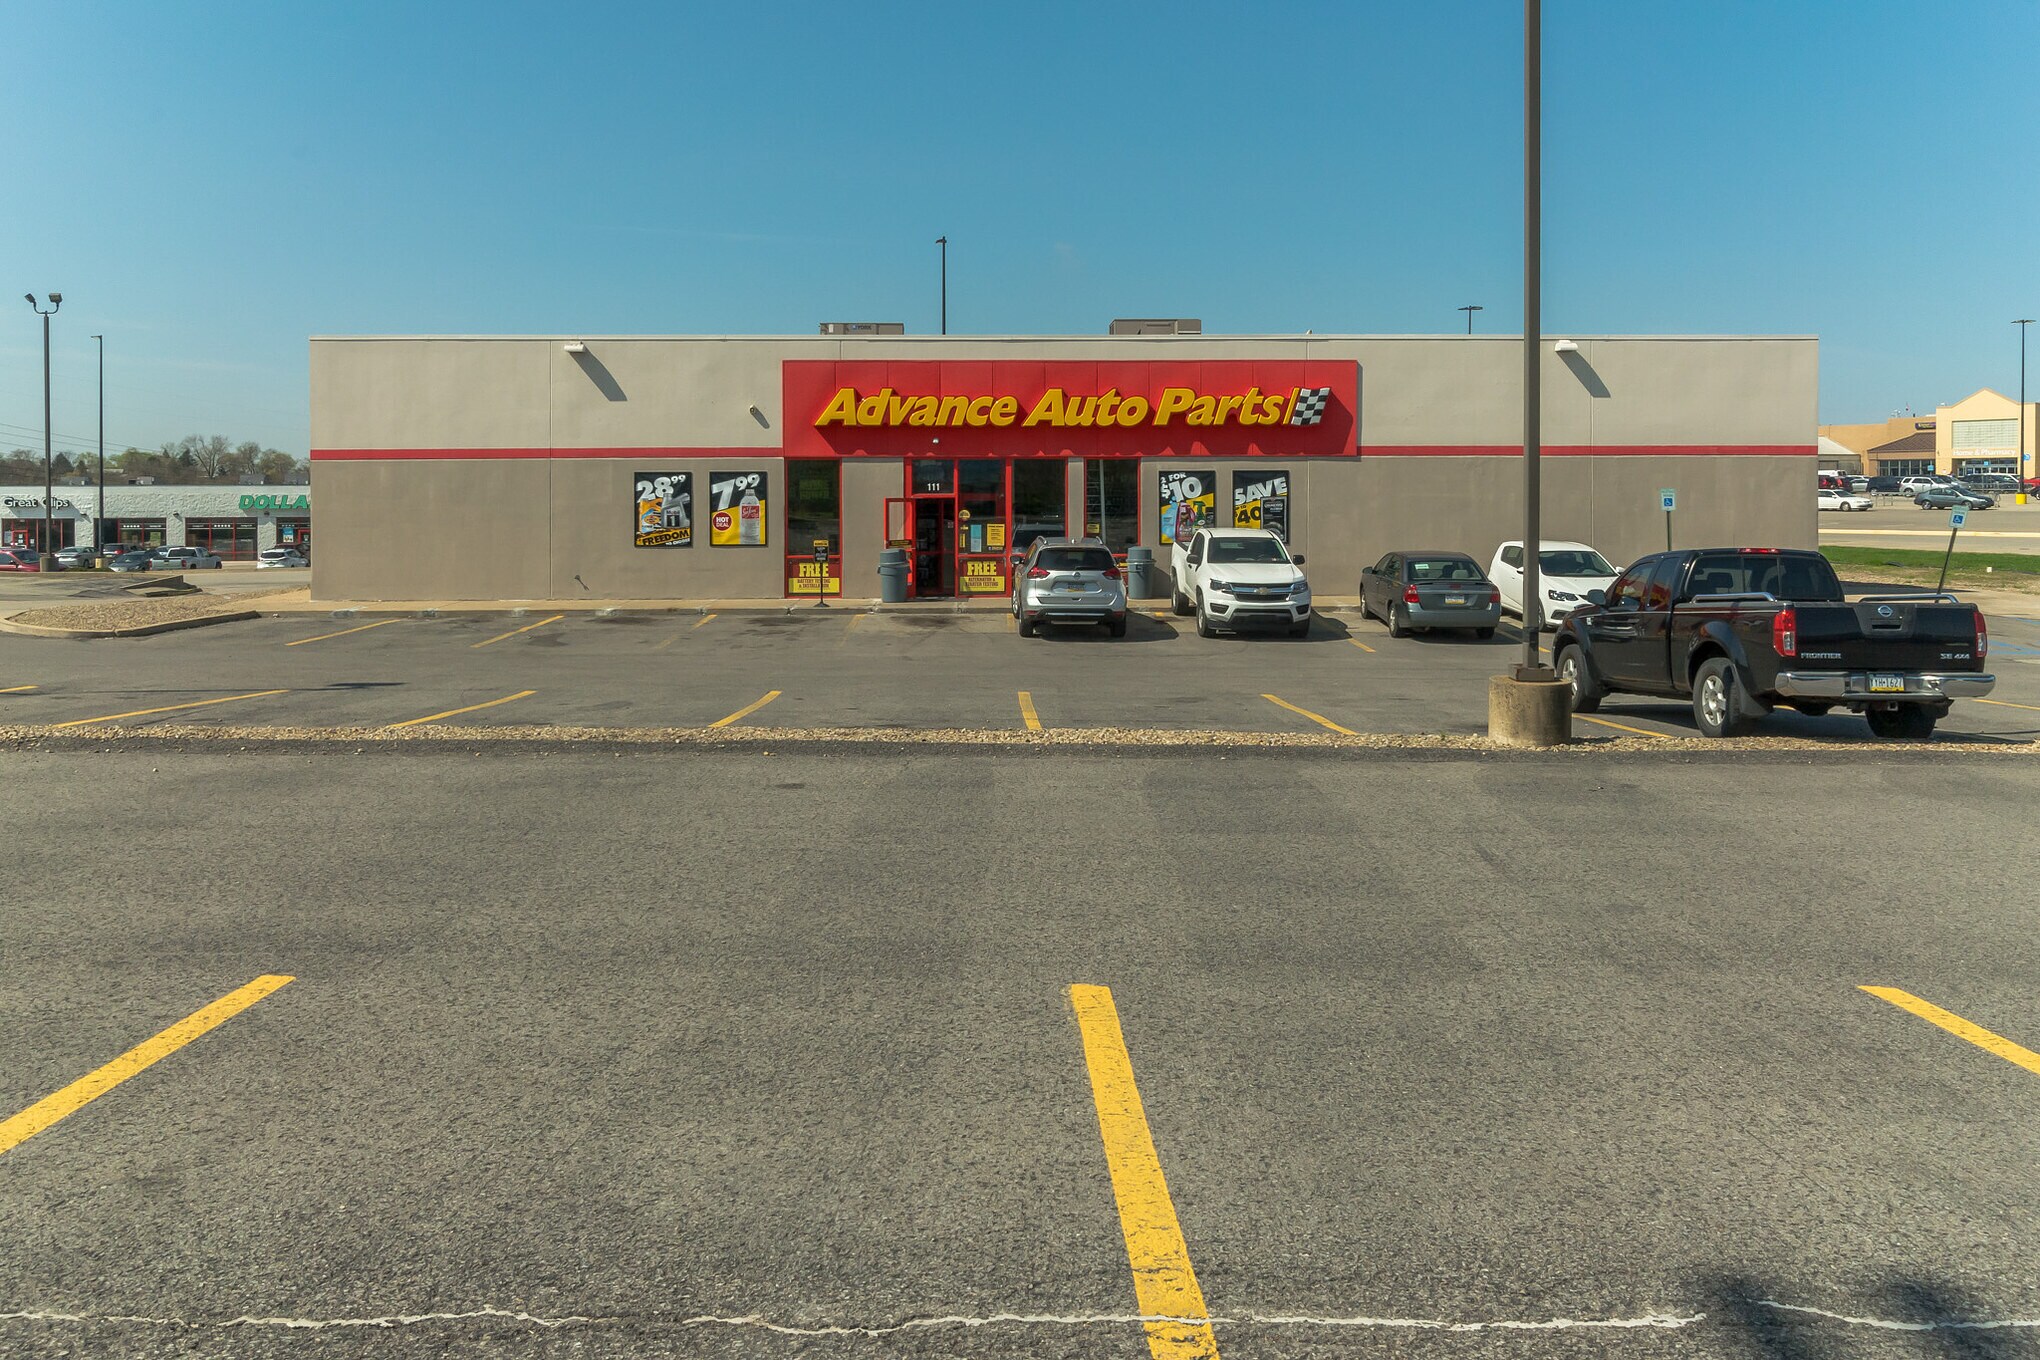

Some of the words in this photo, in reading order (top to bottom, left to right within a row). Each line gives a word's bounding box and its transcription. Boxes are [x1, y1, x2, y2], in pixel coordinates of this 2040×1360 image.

[814, 387, 1018, 427] Advance
[1022, 387, 1149, 427] Auto
[1153, 387, 1285, 427] Parts
[1168, 472, 1187, 481] FOR
[927, 483, 940, 491] 111
[1160, 476, 1202, 503] $10
[1234, 476, 1288, 506] SAVE
[4, 497, 38, 507] Great
[239, 494, 311, 509] DOLLA
[643, 530, 690, 546] FREEDOM
[798, 562, 830, 577] FREE
[967, 561, 997, 576] FREE
